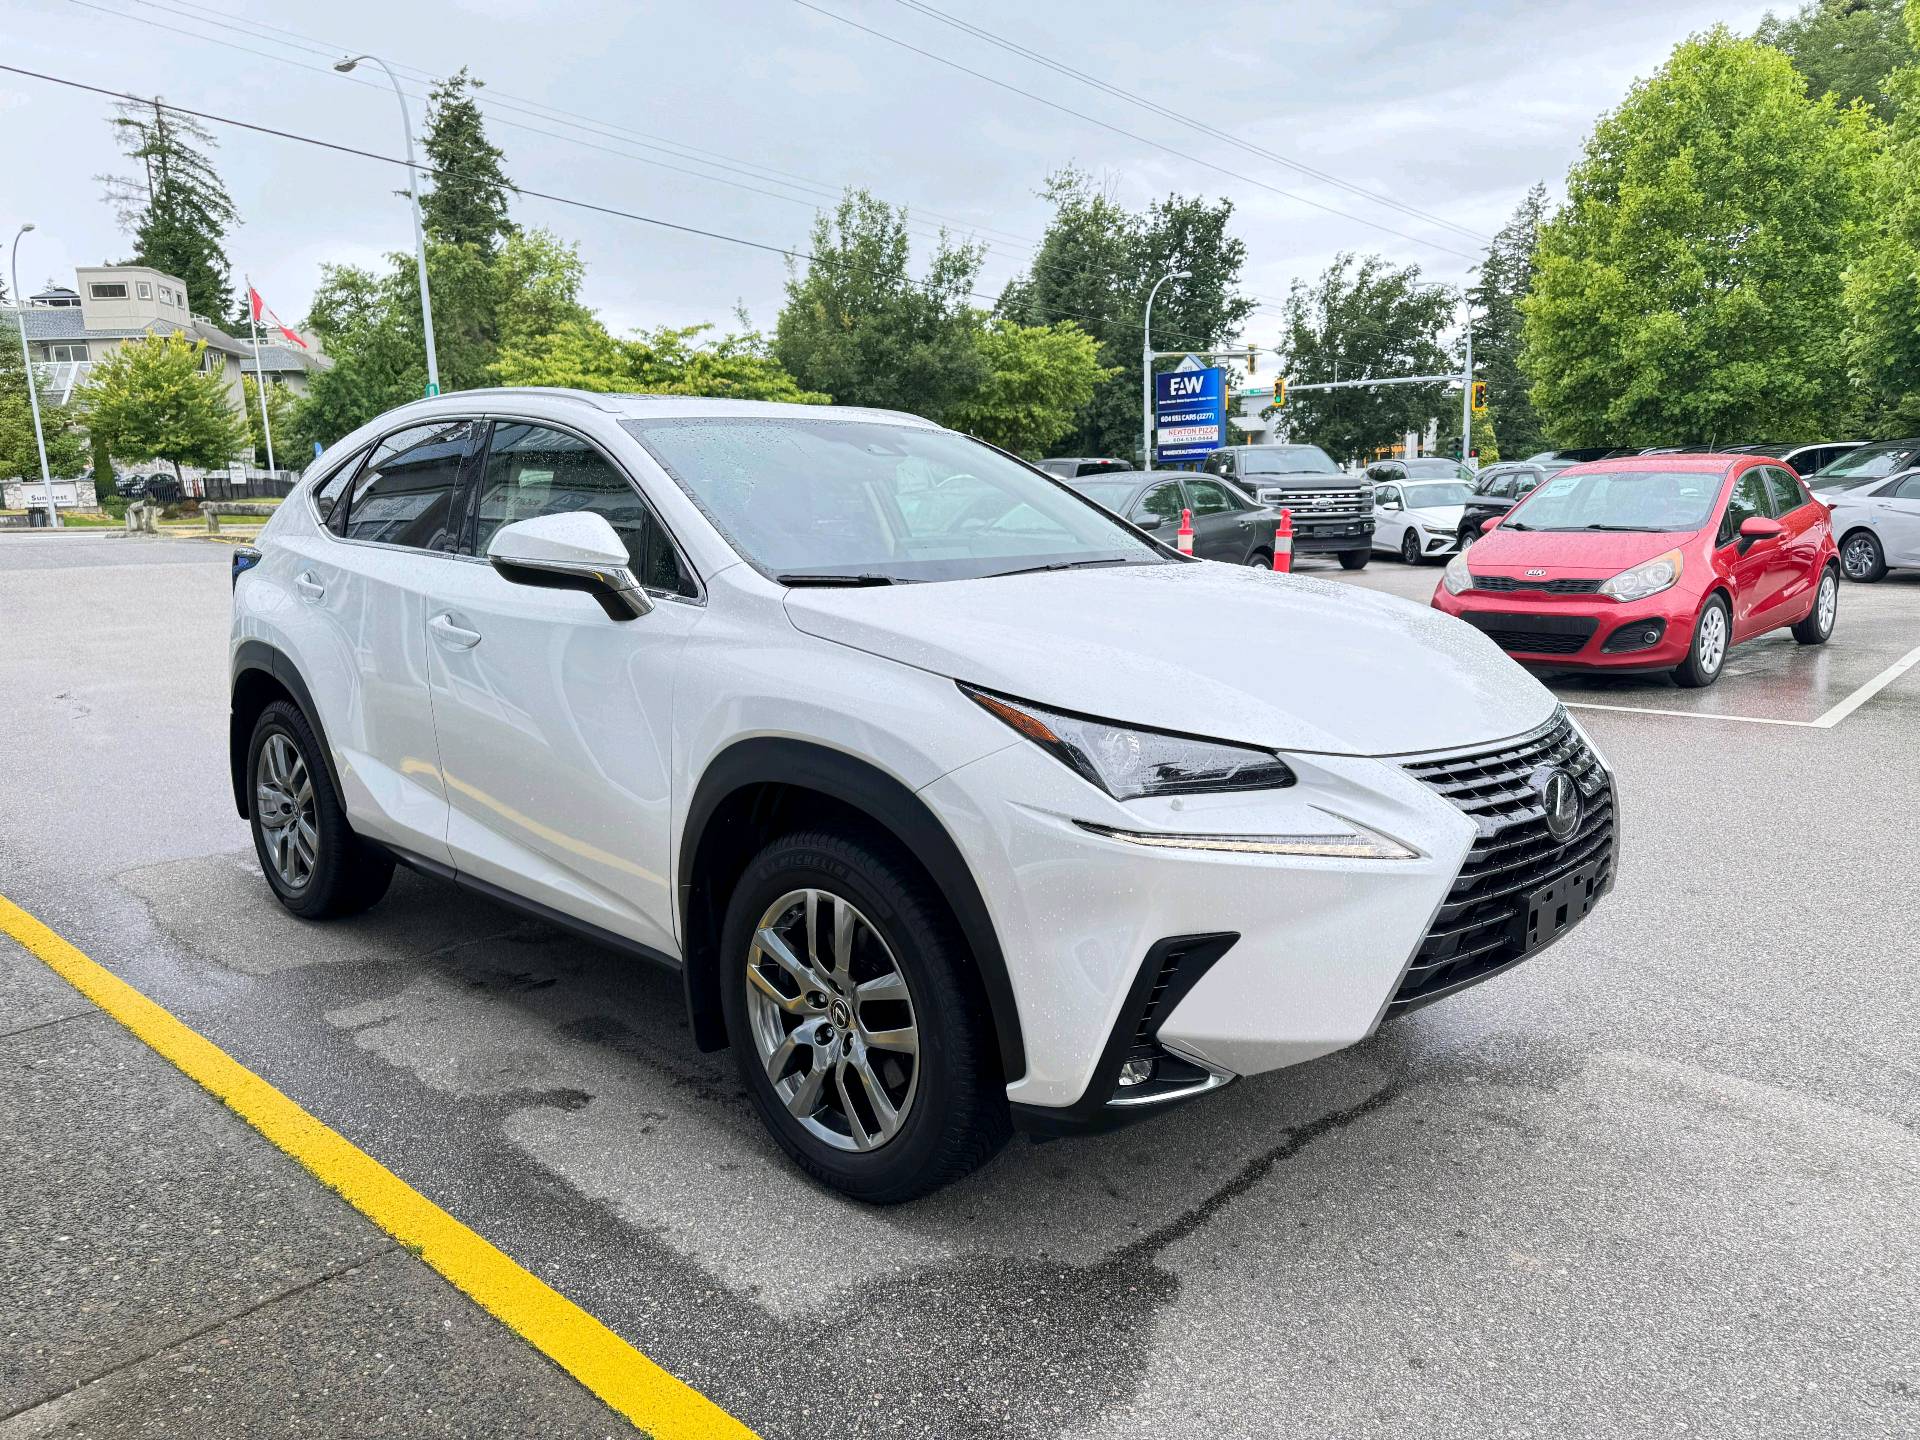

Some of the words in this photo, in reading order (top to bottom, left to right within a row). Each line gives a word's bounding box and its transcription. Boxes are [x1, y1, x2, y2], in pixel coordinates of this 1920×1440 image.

[1160, 415, 1171, 423] 604
[1182, 413, 1197, 421] CARS
[1168, 428, 1197, 436] NEWTON
[1199, 426, 1218, 434] PIZZA
[780, 854, 846, 877] MICHELIN
